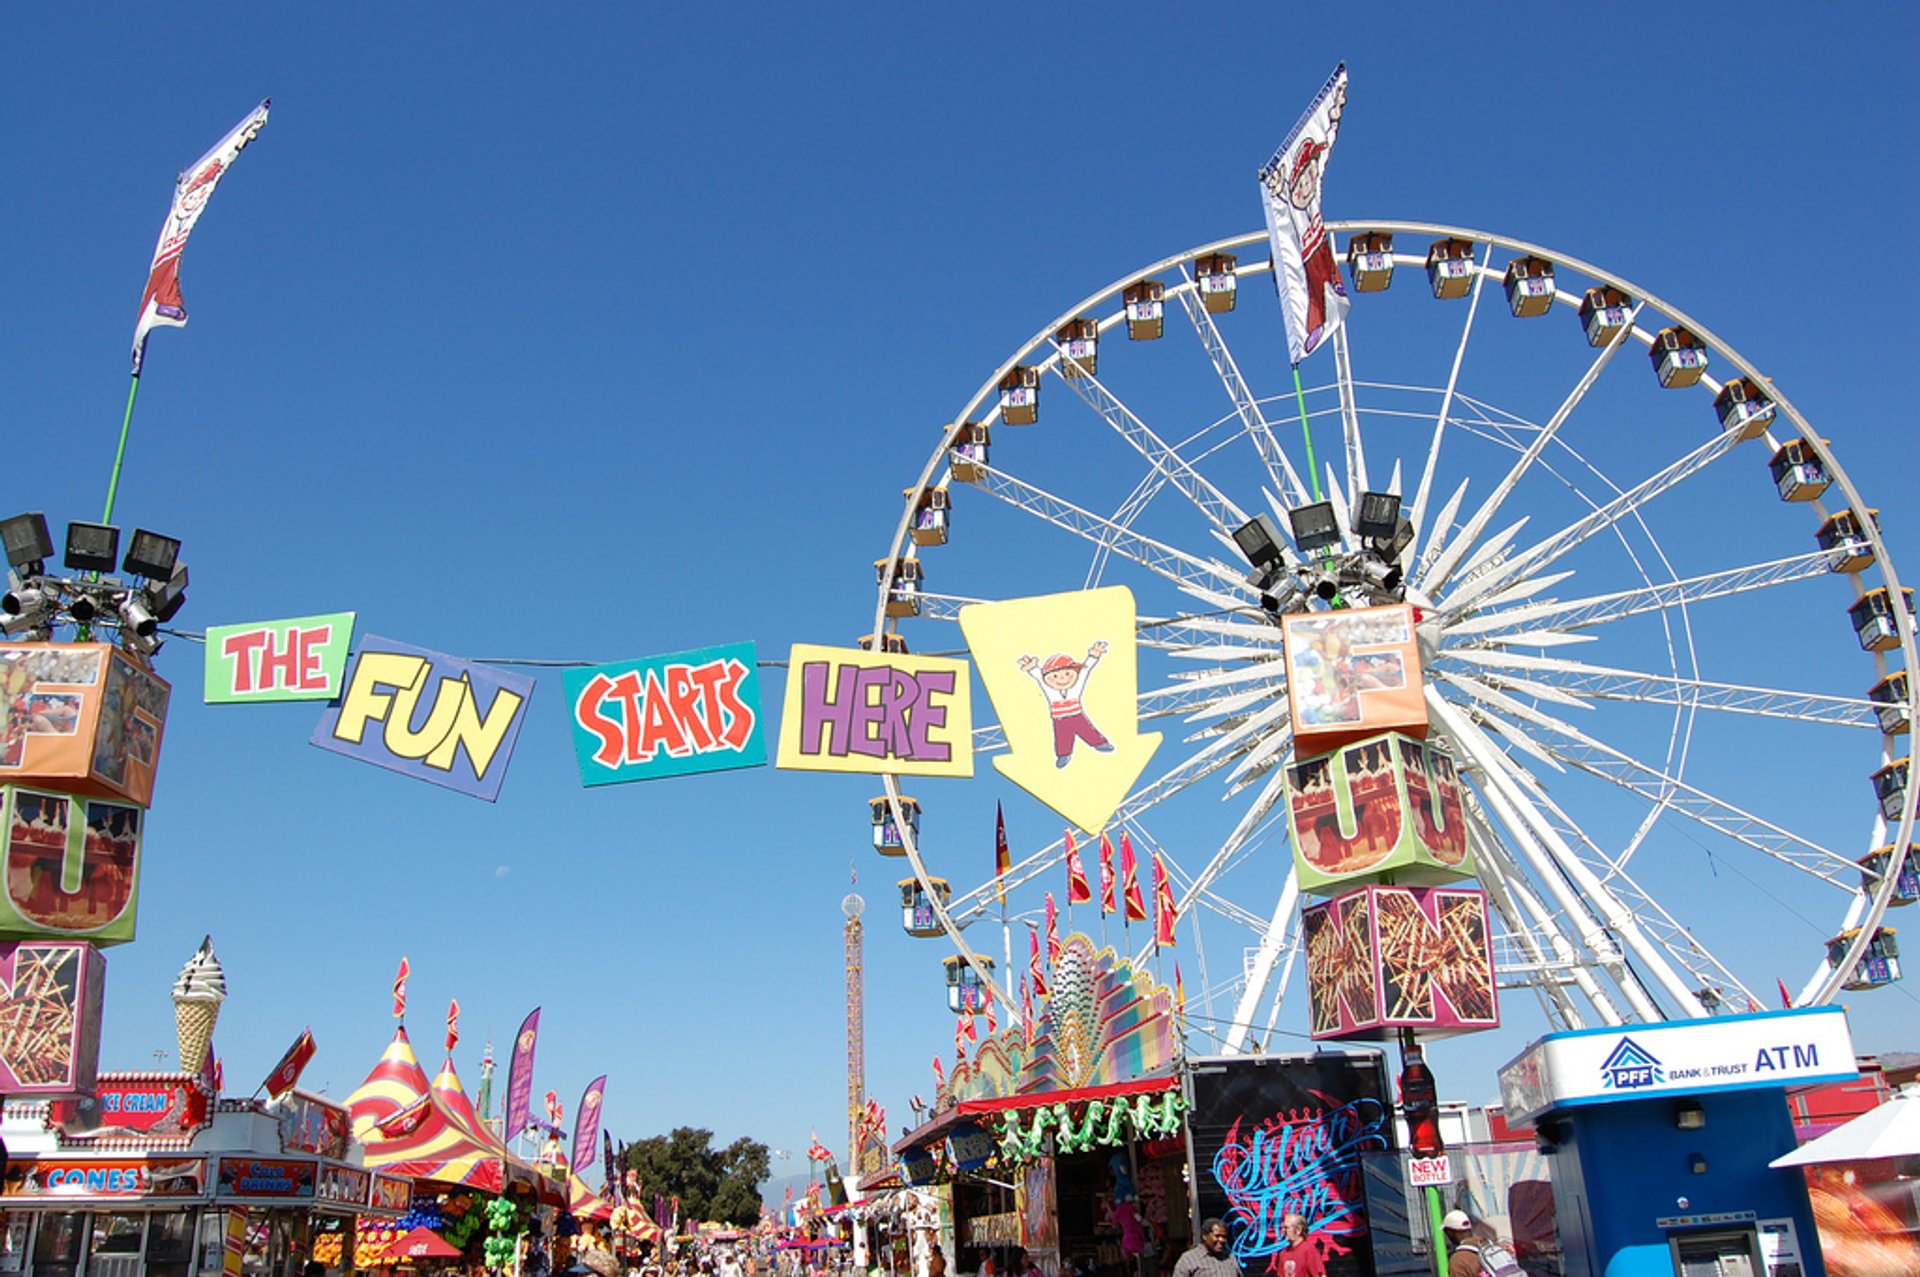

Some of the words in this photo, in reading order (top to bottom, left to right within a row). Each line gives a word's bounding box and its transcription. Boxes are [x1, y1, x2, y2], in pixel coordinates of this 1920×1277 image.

[221, 624, 332, 694] THE
[332, 650, 524, 781] FUN
[575, 658, 755, 769] STARTS
[800, 661, 956, 762] HERE
[1755, 1043, 1819, 1072] ATM
[1617, 1070, 1651, 1086] PFF
[1669, 1067, 1702, 1080] BANK
[1702, 1067, 1711, 1077] &
[1710, 1063, 1748, 1076] TRUST
[101, 1093, 121, 1112] ICE
[123, 1093, 167, 1112] CREAM
[1411, 1159, 1446, 1174] NEW
[47, 1168, 139, 1192] CONES
[240, 1175, 293, 1193] DRINKS
[1412, 1172, 1447, 1184] BOTTLE
